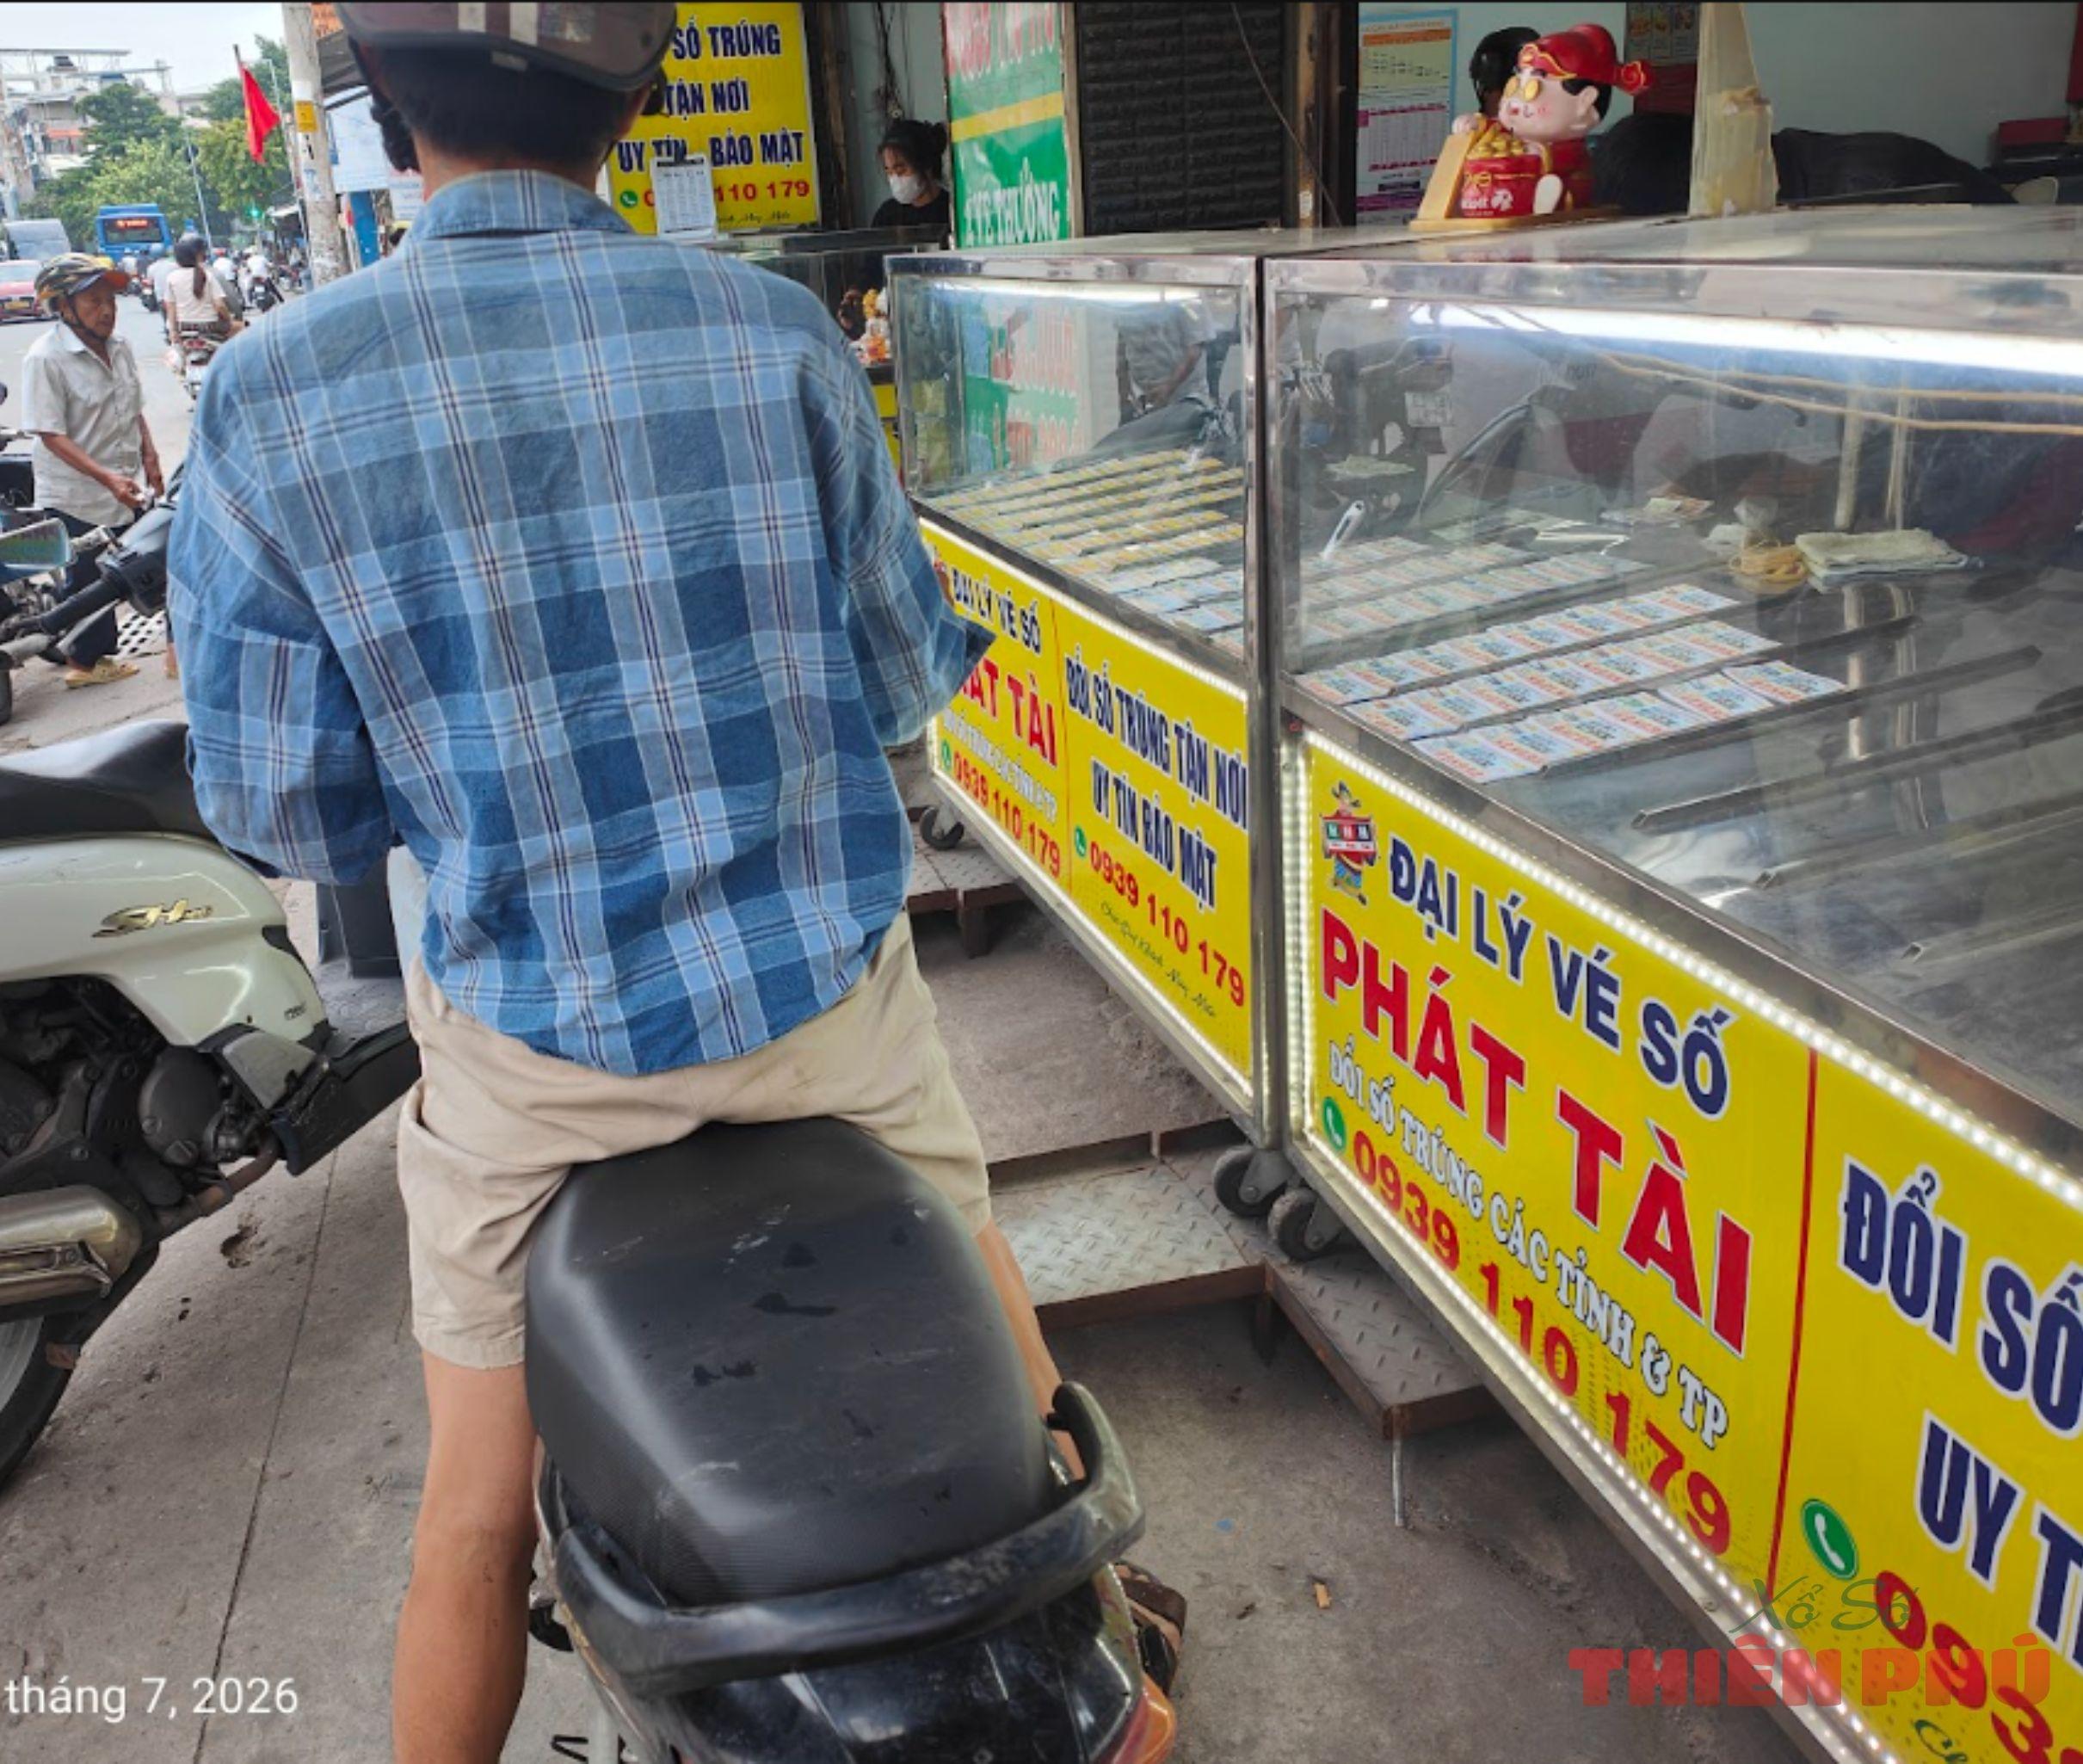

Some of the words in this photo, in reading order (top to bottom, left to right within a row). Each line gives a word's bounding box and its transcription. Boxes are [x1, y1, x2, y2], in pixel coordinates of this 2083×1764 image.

[665, 78, 705, 120] TẬN
[672, 15, 701, 59] SỐ
[707, 20, 780, 57] TRÚNG
[617, 140, 644, 172] UY
[710, 128, 754, 167] BẢO
[761, 127, 804, 168] MẬT
[715, 183, 758, 202] 110
[767, 180, 810, 199] 179
[996, 590, 1017, 639] VÉ
[1020, 600, 1041, 654] SỐ
[1007, 672, 1057, 768] TÀI
[1116, 688, 1171, 774] TRÚNG
[1174, 719, 1211, 804] TẬN
[994, 789, 1022, 840] 110
[1029, 822, 1060, 878] 179
[1092, 759, 1109, 818] UY
[1113, 774, 1138, 844] TÍN
[1179, 826, 1217, 910] MẬT
[1090, 841, 1139, 908] 0939
[1147, 892, 1189, 954] 110
[1199, 941, 1245, 1007] 179
[1389, 832, 1458, 940] ĐẠI
[1474, 894, 1534, 985] LÝ
[1547, 943, 1621, 1052] VÉ
[1638, 1002, 1735, 1119] SỐ
[1321, 906, 1527, 1151] PHÁT
[1557, 1088, 1753, 1357] TÀI
[1368, 1074, 1396, 1136] SỐ
[1401, 1105, 1484, 1220] TRÚNG
[1489, 1192, 1549, 1283] CÁC
[1555, 1246, 1634, 1367] TỈNH
[1641, 1331, 1672, 1397] &
[1678, 1363, 1729, 1450] TP
[1840, 1155, 1967, 1351] ĐỔI
[1981, 1260, 2083, 1435] SỐ
[1353, 1130, 1460, 1272] 0939
[1479, 1261, 1579, 1397] 110
[1606, 1391, 1730, 1555] 179
[1917, 1413, 2023, 1590] UY
[1874, 1570, 2083, 1764] 093
